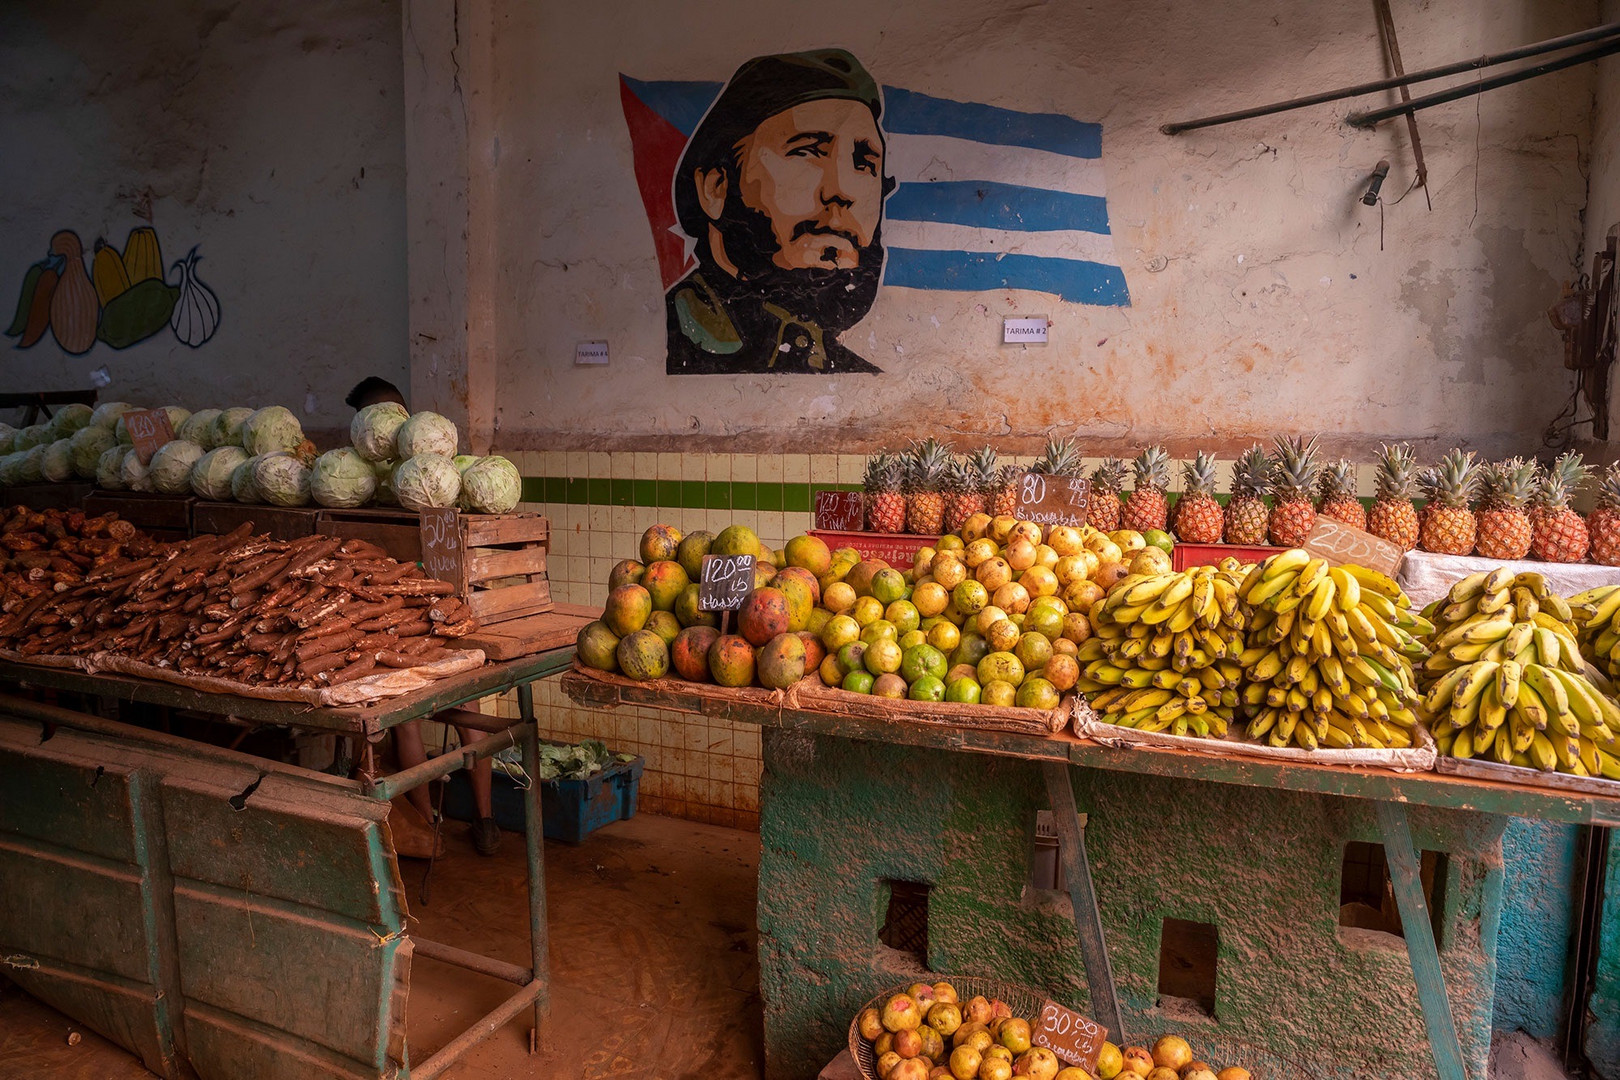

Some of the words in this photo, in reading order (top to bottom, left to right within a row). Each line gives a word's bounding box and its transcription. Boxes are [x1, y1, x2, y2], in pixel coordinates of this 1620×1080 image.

[1042, 327, 1047, 335] 2
[1022, 474, 1046, 504] 80
[705, 558, 736, 583] 120
